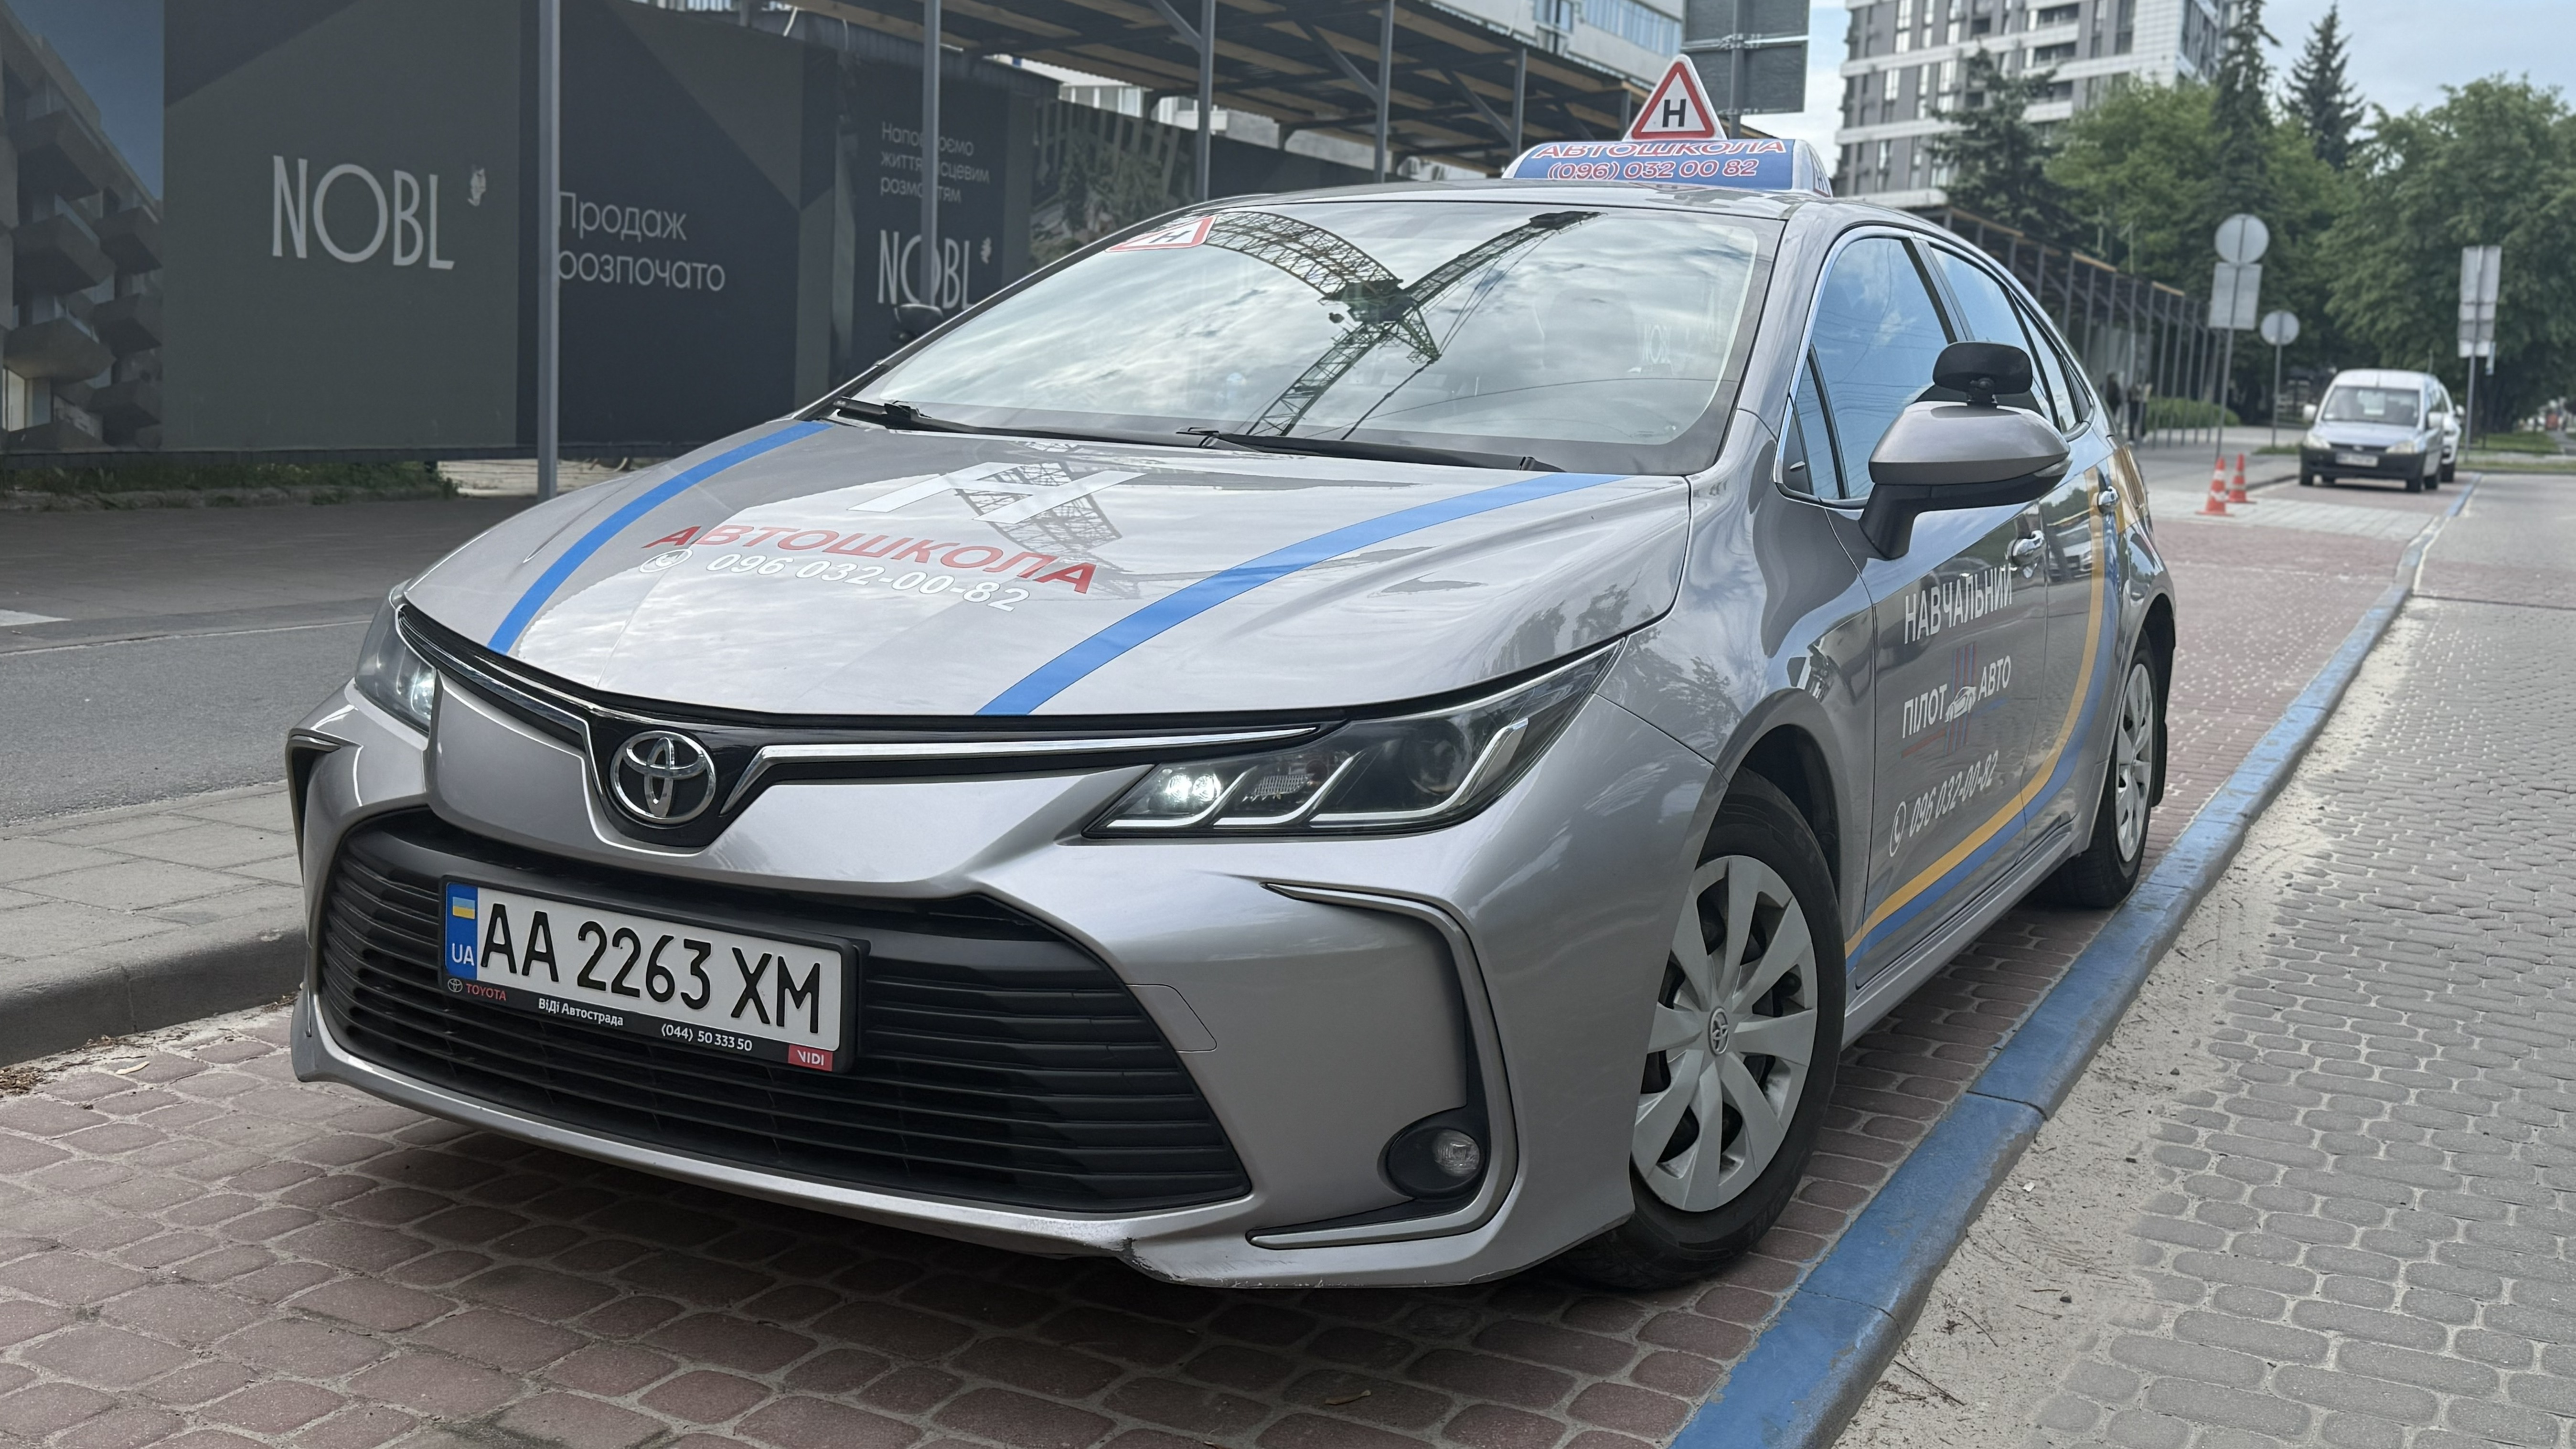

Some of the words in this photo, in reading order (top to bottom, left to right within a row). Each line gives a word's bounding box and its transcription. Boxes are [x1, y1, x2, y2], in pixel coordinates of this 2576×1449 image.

[1531, 140, 1786, 158] АВТОШКОЛА
[1548, 161, 1620, 180] (096)
[1624, 161, 1676, 179] 032
[1679, 160, 1719, 178] 00
[1722, 159, 1759, 177] 82
[272, 155, 455, 270] NOBL
[558, 191, 687, 243] Продаж
[641, 525, 1096, 594] АВТОШКОЛА
[706, 554, 794, 575] 096
[796, 560, 1029, 612] 032-00-82
[1904, 552, 2012, 644] НАВЧАЛЬНИЙ
[1903, 683, 1947, 738] ПІЛОТ
[1977, 655, 2011, 701] АВТО
[1909, 787, 1936, 837] 096
[1935, 750, 1999, 819] 032-00-82
[451, 943, 475, 966] UA
[577, 920, 711, 1010] 2263
[466, 983, 507, 1002] TOYOTA
[539, 998, 560, 1013] ВіДі
[562, 1003, 623, 1027] Автострада
[661, 1023, 693, 1042] (044)
[697, 1031, 713, 1044] 50
[715, 1033, 735, 1048] 333
[737, 1038, 753, 1051] 50
[797, 1050, 824, 1065] VIDI
